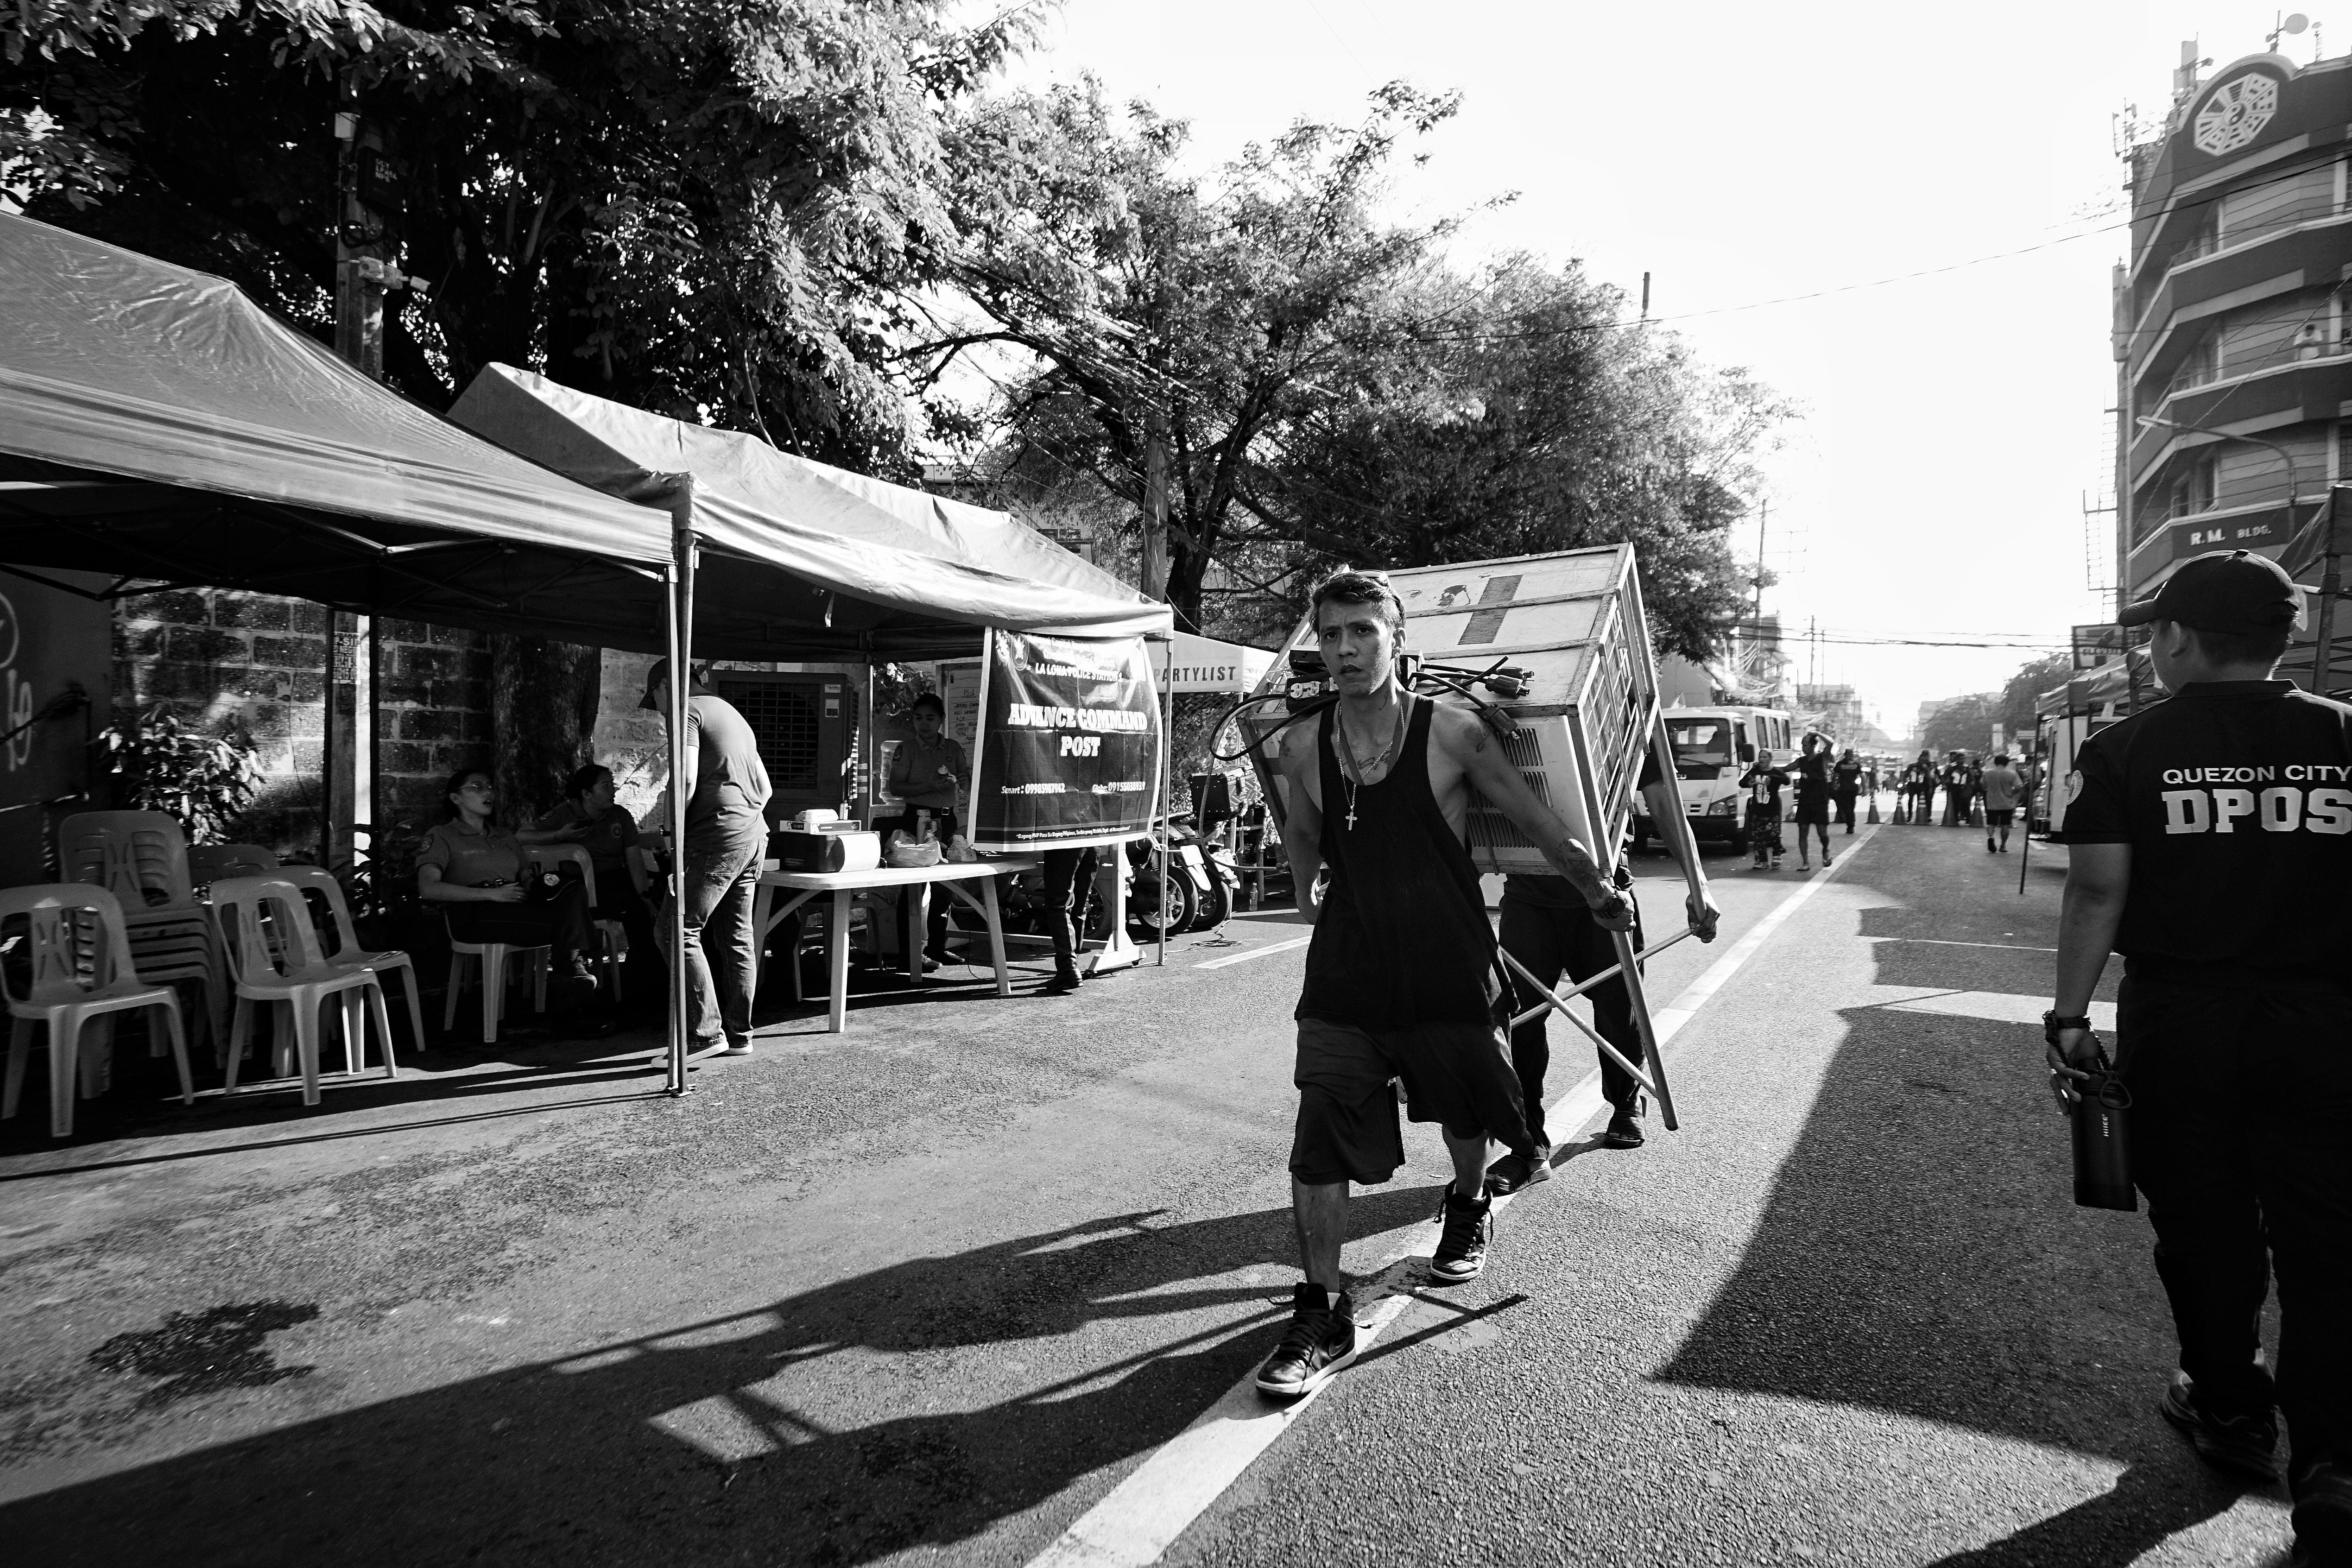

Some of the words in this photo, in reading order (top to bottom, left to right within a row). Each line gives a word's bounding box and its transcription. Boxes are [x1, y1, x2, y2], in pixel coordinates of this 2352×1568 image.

[2190, 528, 2226, 545] R.M.
[1035, 662, 1046, 674] LA
[1008, 704, 1077, 728] ADVANCE
[1077, 708, 1147, 730] COMMAND
[1060, 736, 1101, 757] POST
[2162, 766, 2275, 784] QUEZON
[2285, 765, 2352, 782] CITY
[2161, 787, 2352, 835] DPOS
